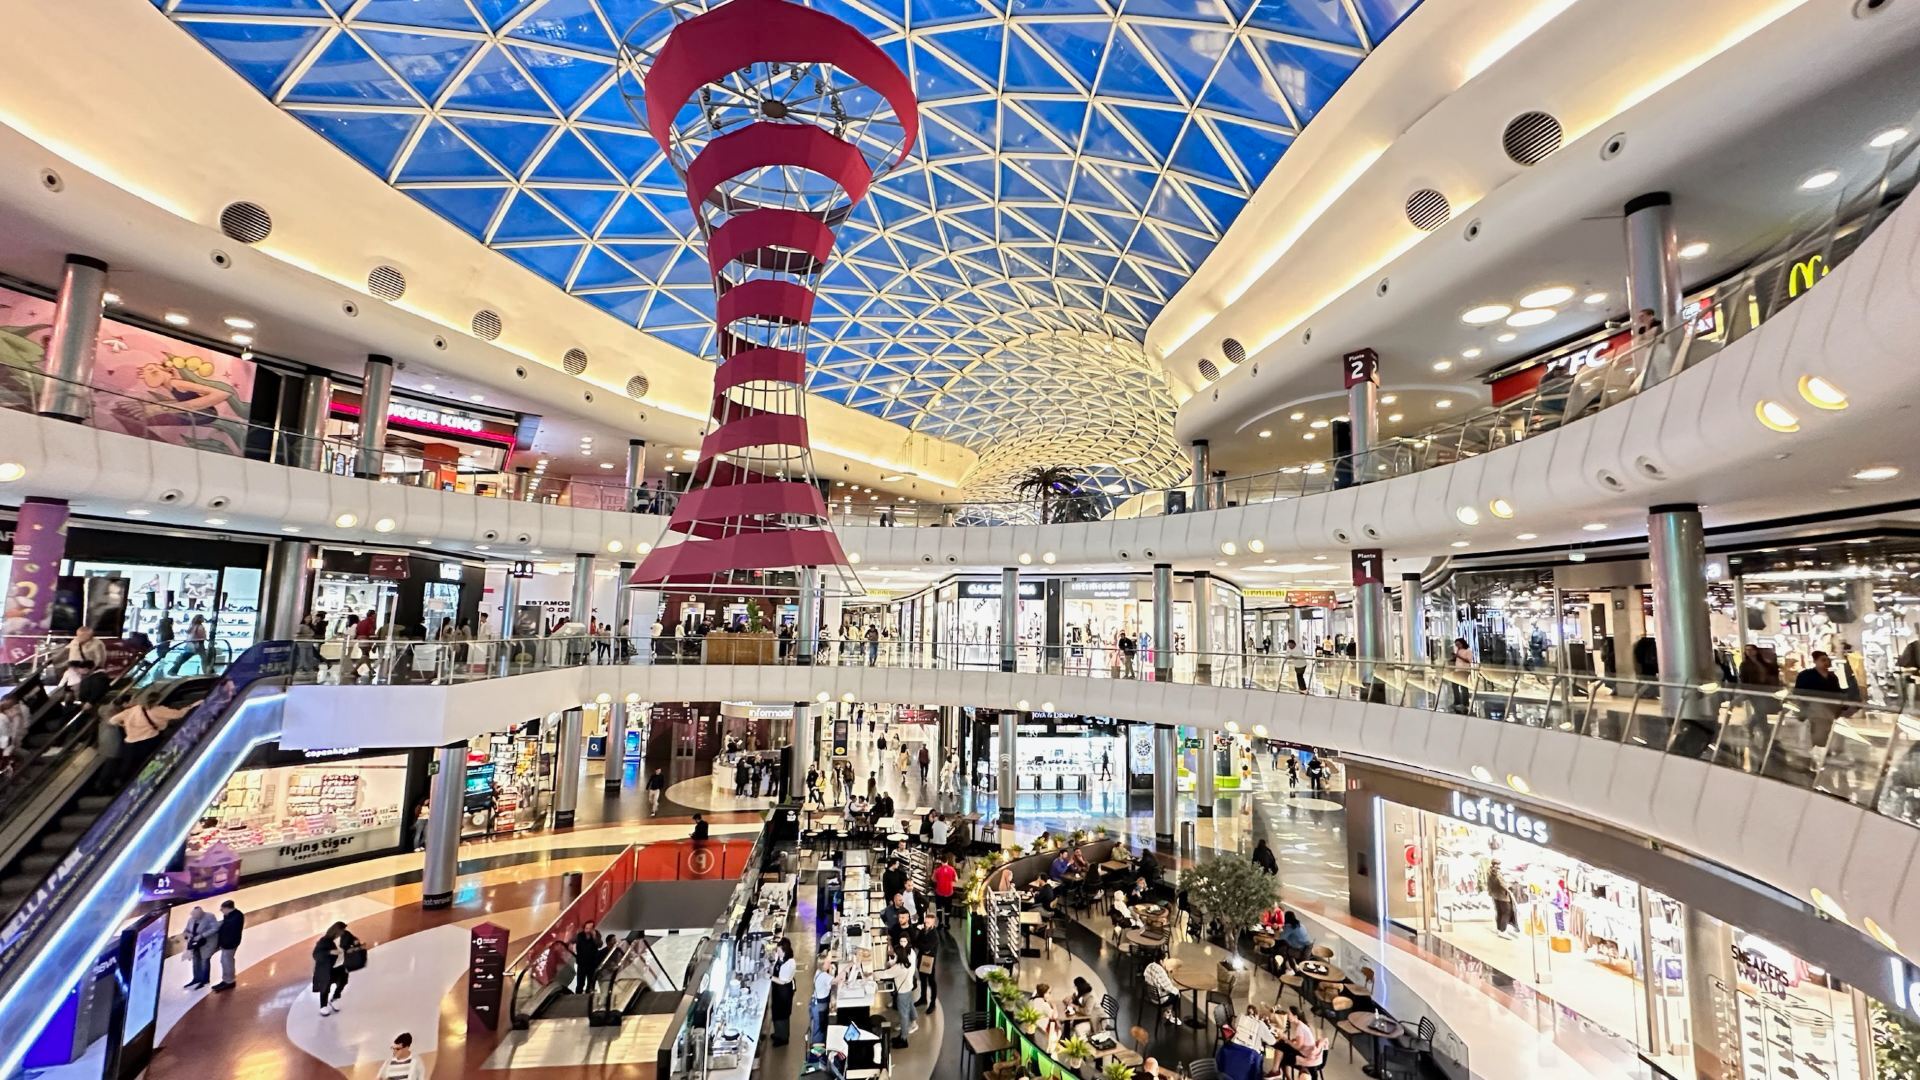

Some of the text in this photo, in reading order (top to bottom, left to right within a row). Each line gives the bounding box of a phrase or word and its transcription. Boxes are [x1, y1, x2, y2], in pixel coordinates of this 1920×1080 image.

[1351, 360, 1364, 379] 2
[441, 413, 483, 432] KING
[1361, 560, 1372, 578] 1
[1452, 790, 1549, 844] lefties
[279, 836, 354, 857] flying tiger
[1730, 944, 1790, 987] SNEAKERS
[1736, 962, 1787, 1001] WORLD
